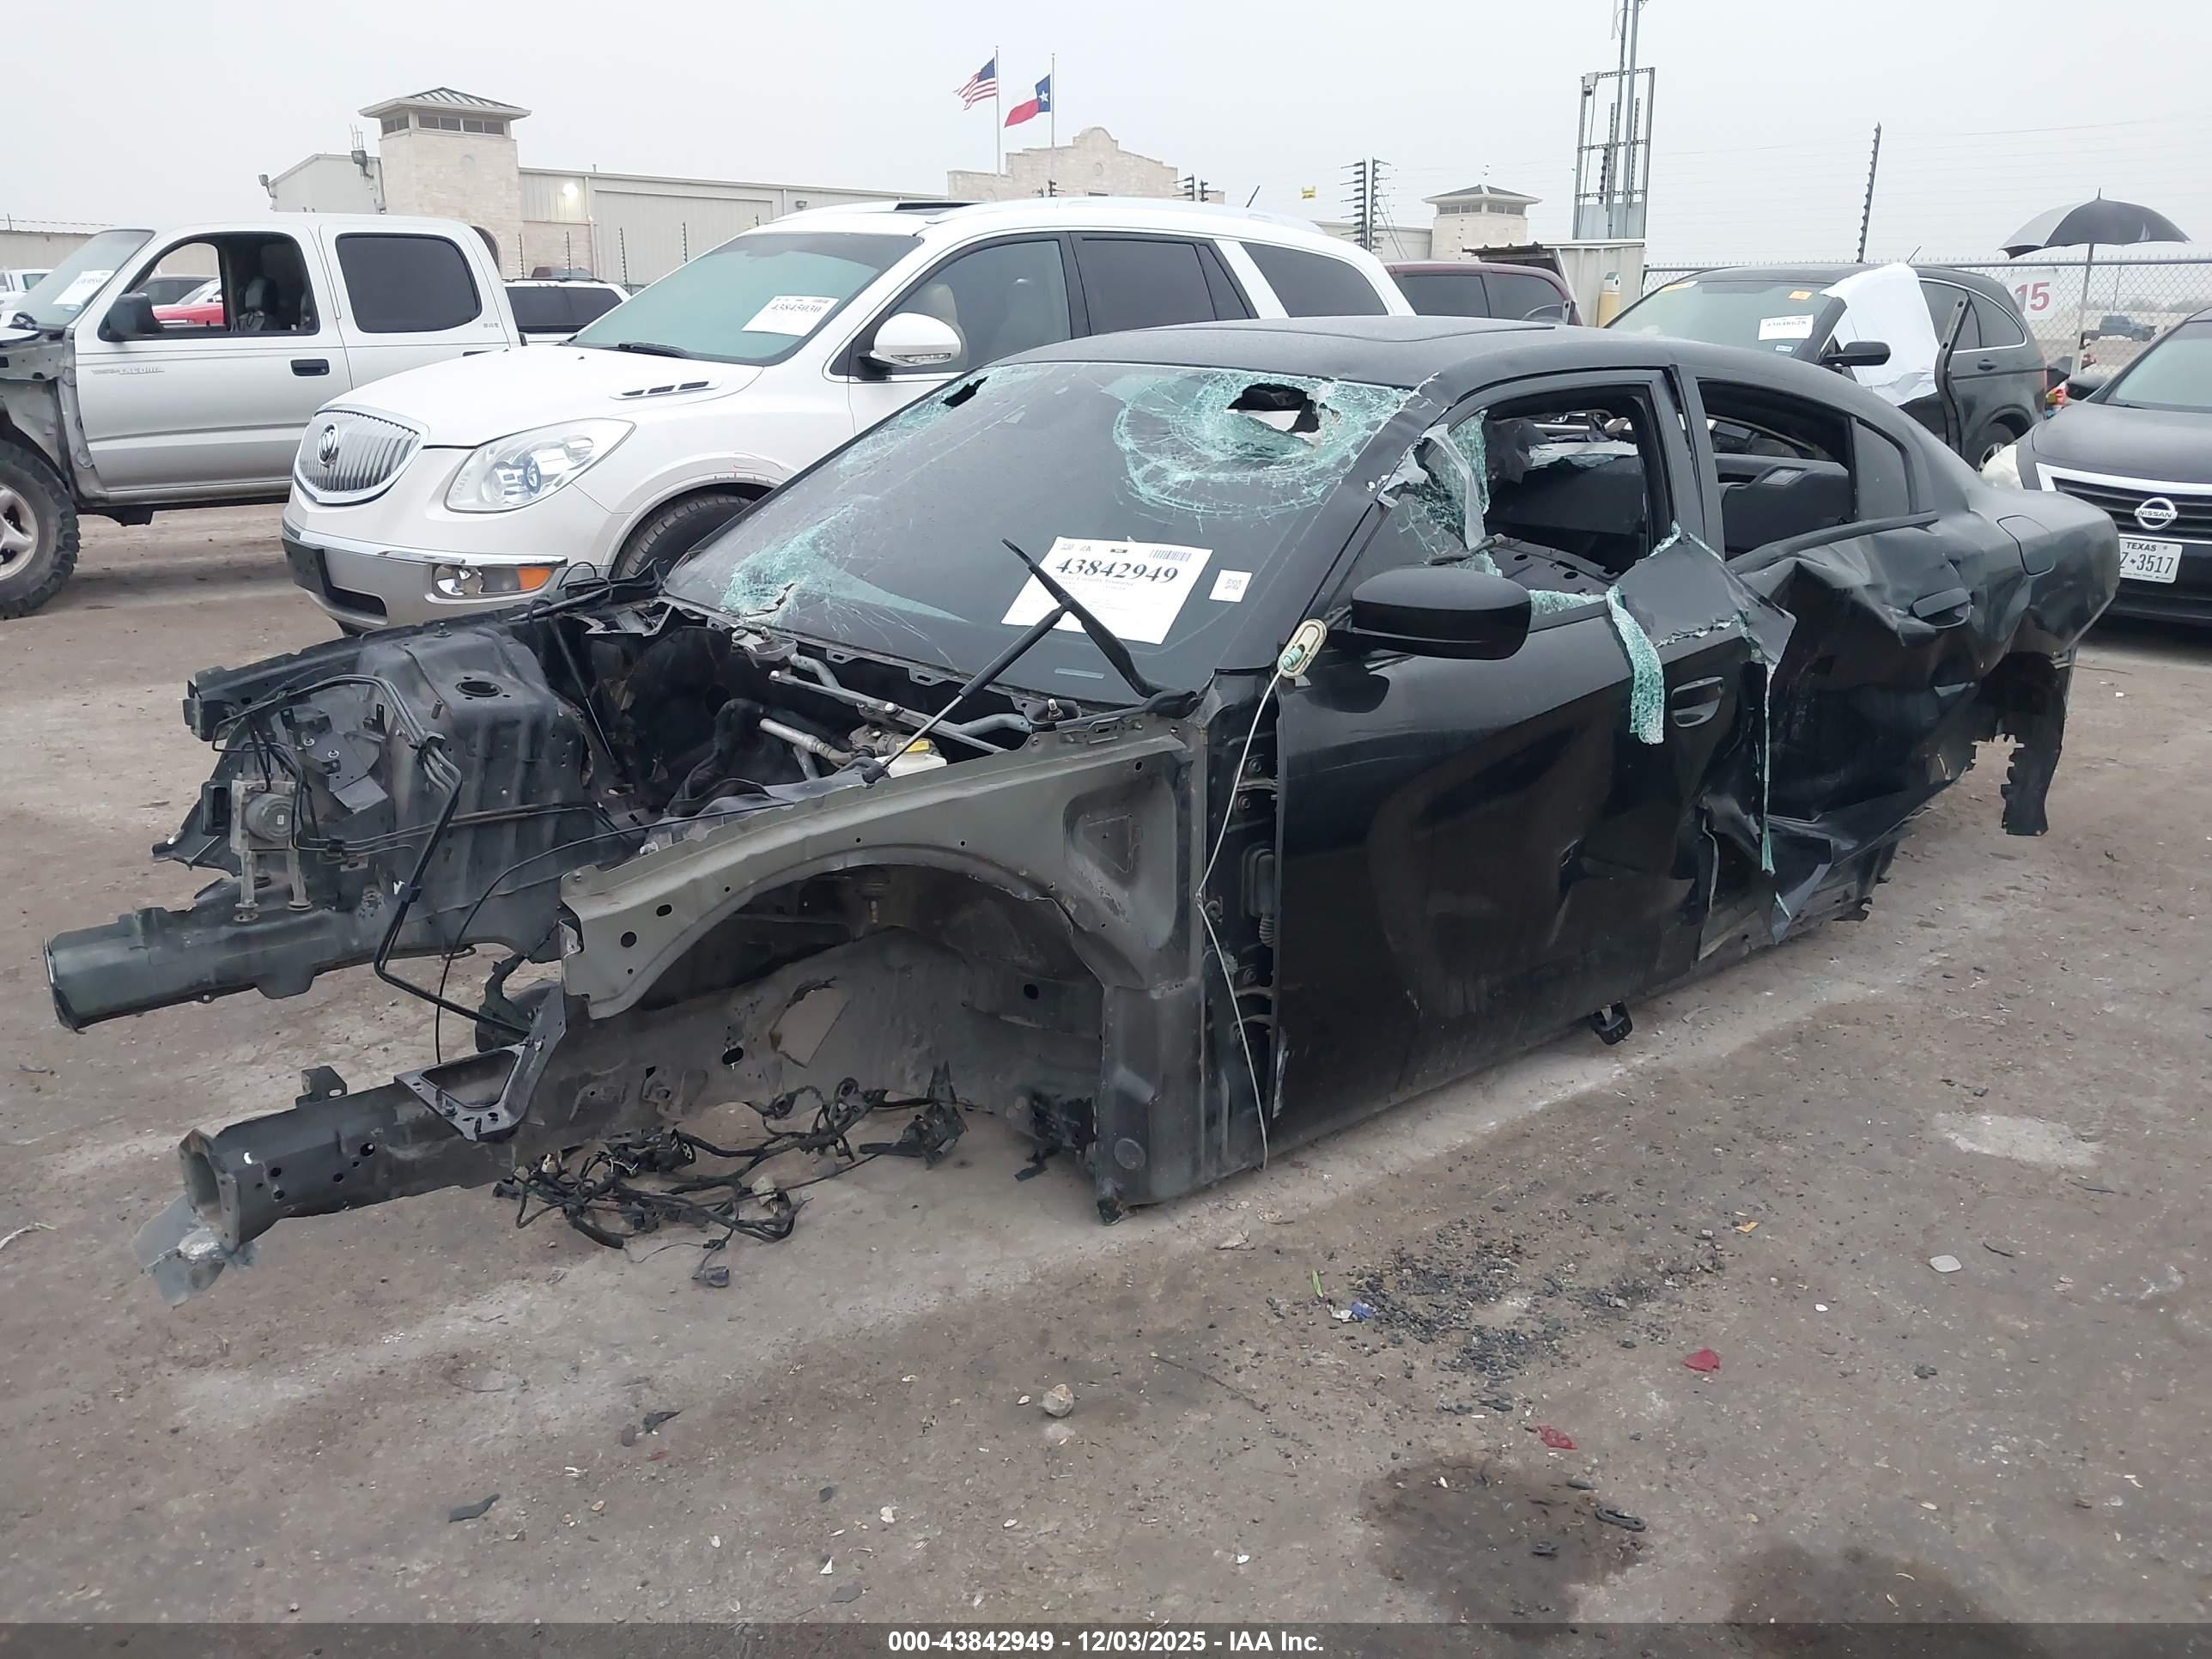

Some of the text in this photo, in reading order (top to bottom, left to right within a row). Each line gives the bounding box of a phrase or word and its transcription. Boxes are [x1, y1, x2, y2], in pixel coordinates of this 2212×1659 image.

[2014, 282, 2050, 312] 15
[2137, 509, 2172, 519] NISSAN
[2126, 541, 2157, 552] TEXAS
[1055, 557, 1179, 584] 43842949
